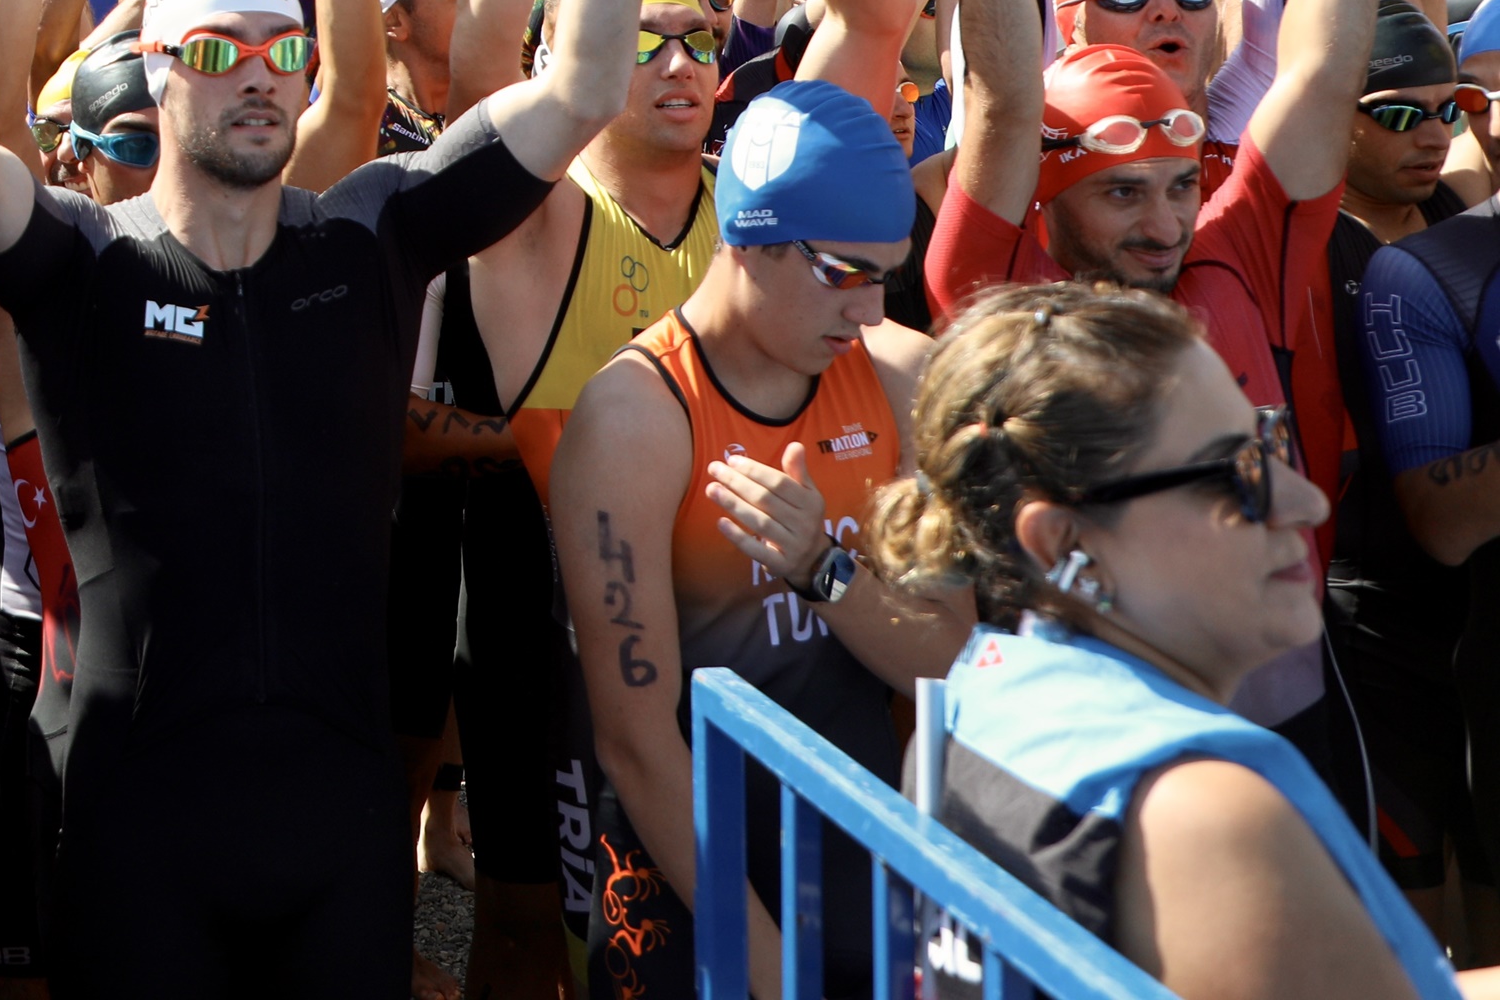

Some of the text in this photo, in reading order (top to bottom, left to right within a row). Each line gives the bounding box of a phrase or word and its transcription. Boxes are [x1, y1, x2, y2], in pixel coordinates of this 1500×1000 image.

[88, 81, 129, 112] speedo
[734, 217, 779, 228] WAVE
[737, 209, 773, 219] MAD
[290, 284, 349, 311] orca
[1365, 292, 1428, 424] HUUB
